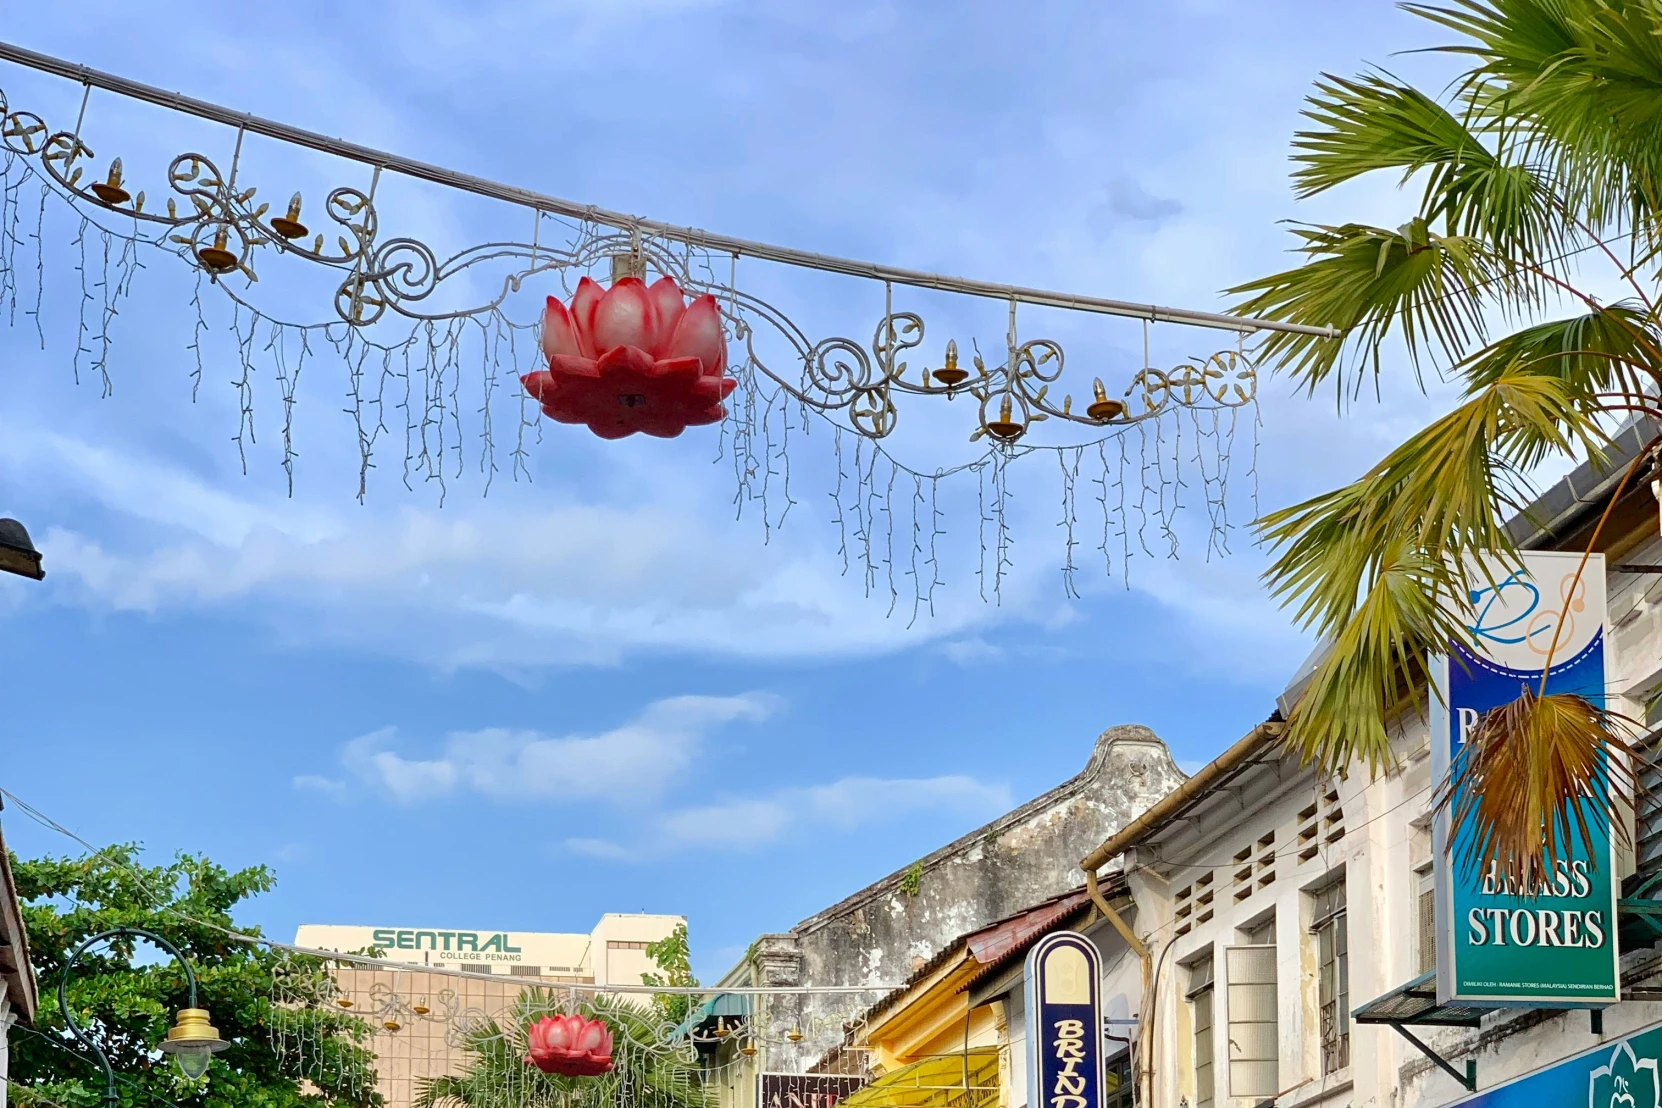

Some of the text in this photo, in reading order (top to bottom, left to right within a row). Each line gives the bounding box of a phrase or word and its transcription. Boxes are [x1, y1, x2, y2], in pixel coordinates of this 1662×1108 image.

[1468, 907, 1603, 949] STORES
[373, 929, 521, 953] SENTRAL
[440, 951, 522, 962] COLLEGE PENANG
[1540, 982, 1567, 990] (MALAYSIA)
